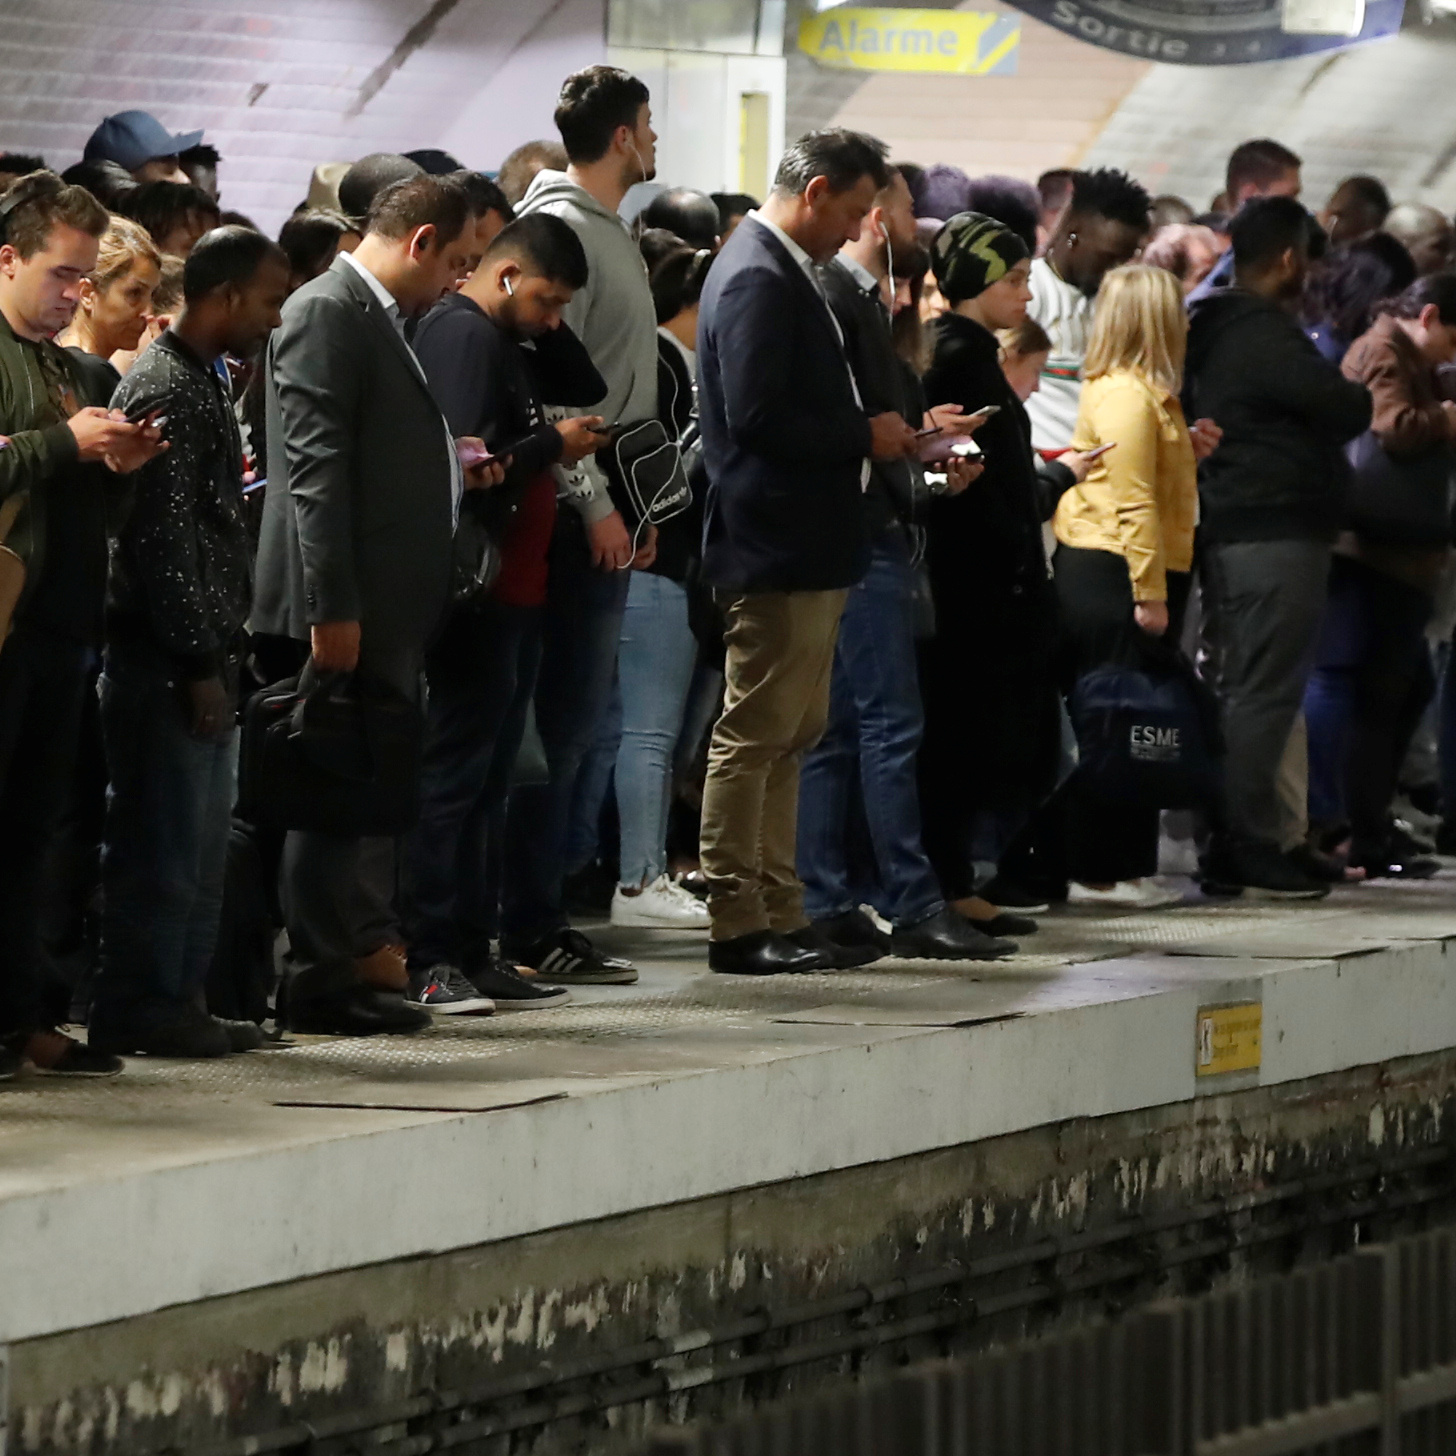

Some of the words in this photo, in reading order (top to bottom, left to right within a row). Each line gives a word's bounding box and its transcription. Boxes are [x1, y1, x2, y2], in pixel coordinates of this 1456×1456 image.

[820, 20, 959, 56] Alarme
[1051, 0, 1190, 59] Sortie
[652, 493, 681, 512] adidas
[1130, 725, 1180, 746] ESME
